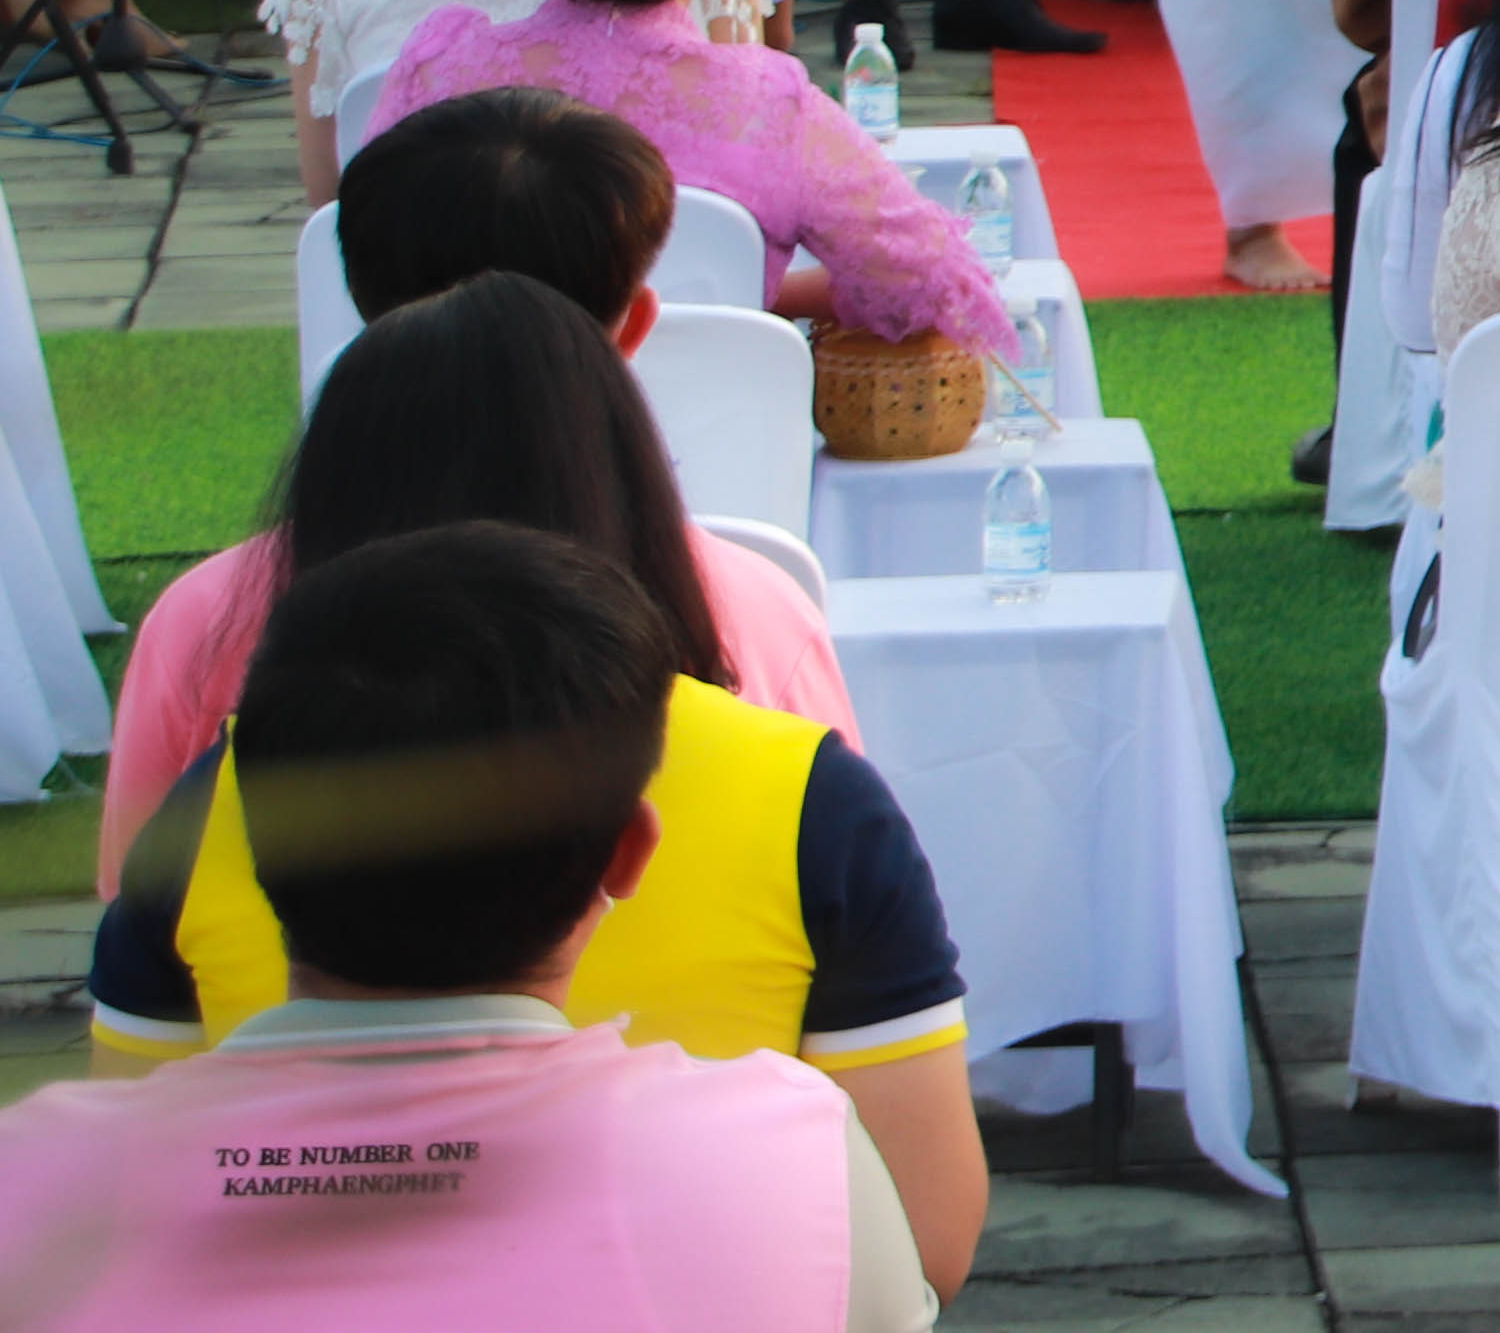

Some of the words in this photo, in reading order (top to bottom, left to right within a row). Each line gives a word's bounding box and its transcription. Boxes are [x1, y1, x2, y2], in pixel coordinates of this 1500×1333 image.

[216, 1147, 250, 1167] TO
[258, 1146, 292, 1166] BE
[300, 1143, 413, 1166] NUMBER
[426, 1140, 481, 1162] ONE
[222, 1172, 465, 1197] KAMPHAENGPHET
